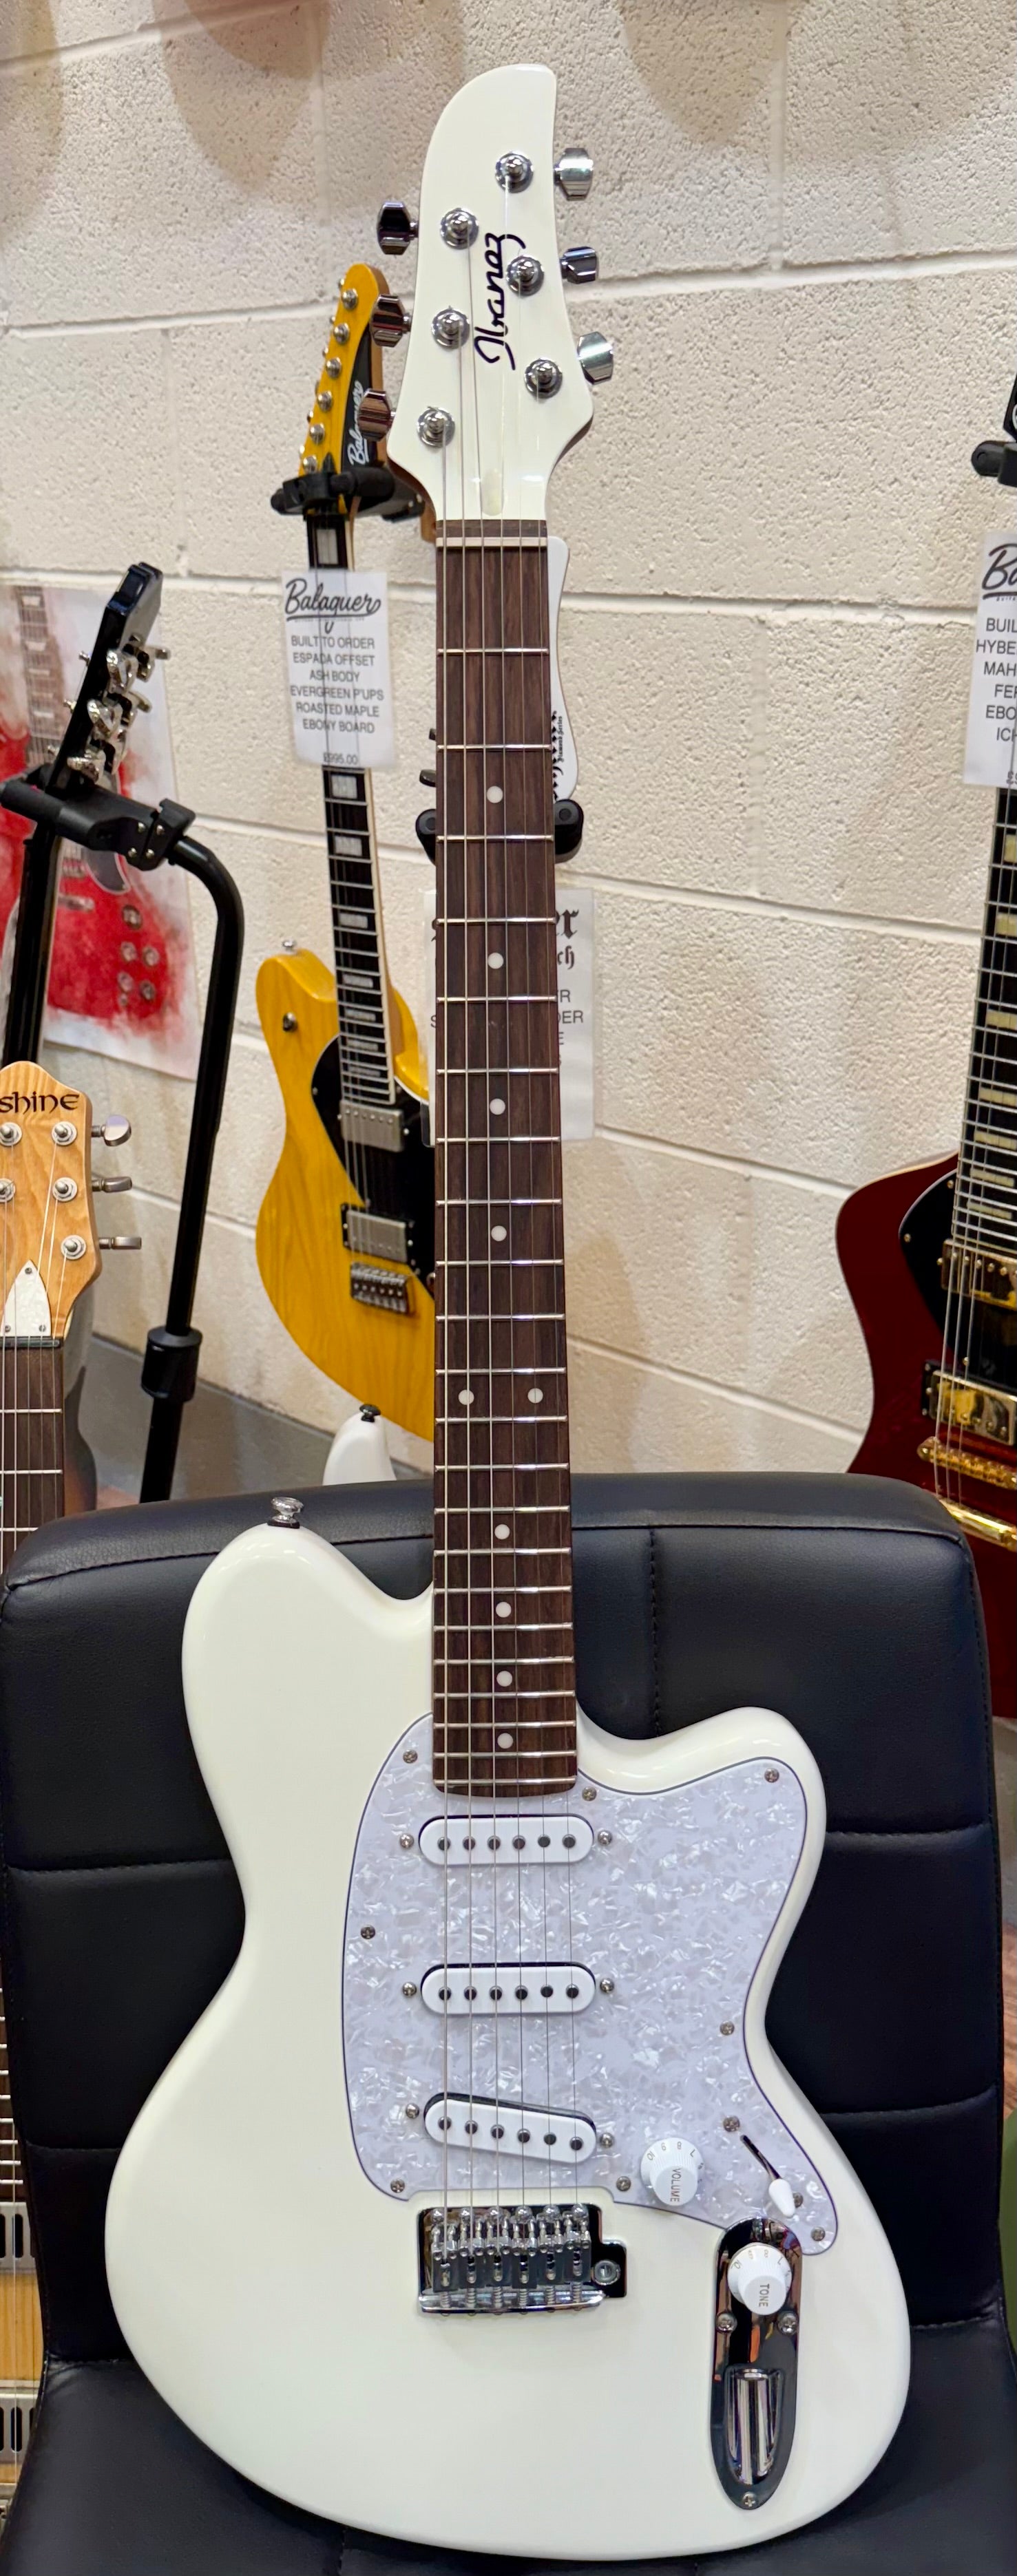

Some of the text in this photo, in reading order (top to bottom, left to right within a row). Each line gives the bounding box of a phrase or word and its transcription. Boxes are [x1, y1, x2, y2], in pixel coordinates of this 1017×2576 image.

[474, 233, 526, 371] Ibanez
[285, 578, 381, 633] Balaguer
[291, 635, 375, 649] BUILT TO ORDER
[293, 652, 375, 666] ESPADA OFFSET
[310, 670, 360, 682] ASH BODY
[984, 662, 1016, 677] MAH
[291, 685, 384, 700] EVERGREEN P'UPS
[296, 702, 379, 717] ROASTED MAPLE
[303, 719, 375, 734] EBONY BOARD
[671, 2168, 682, 2202] VOLUME
[759, 2283, 770, 2308] TONE
